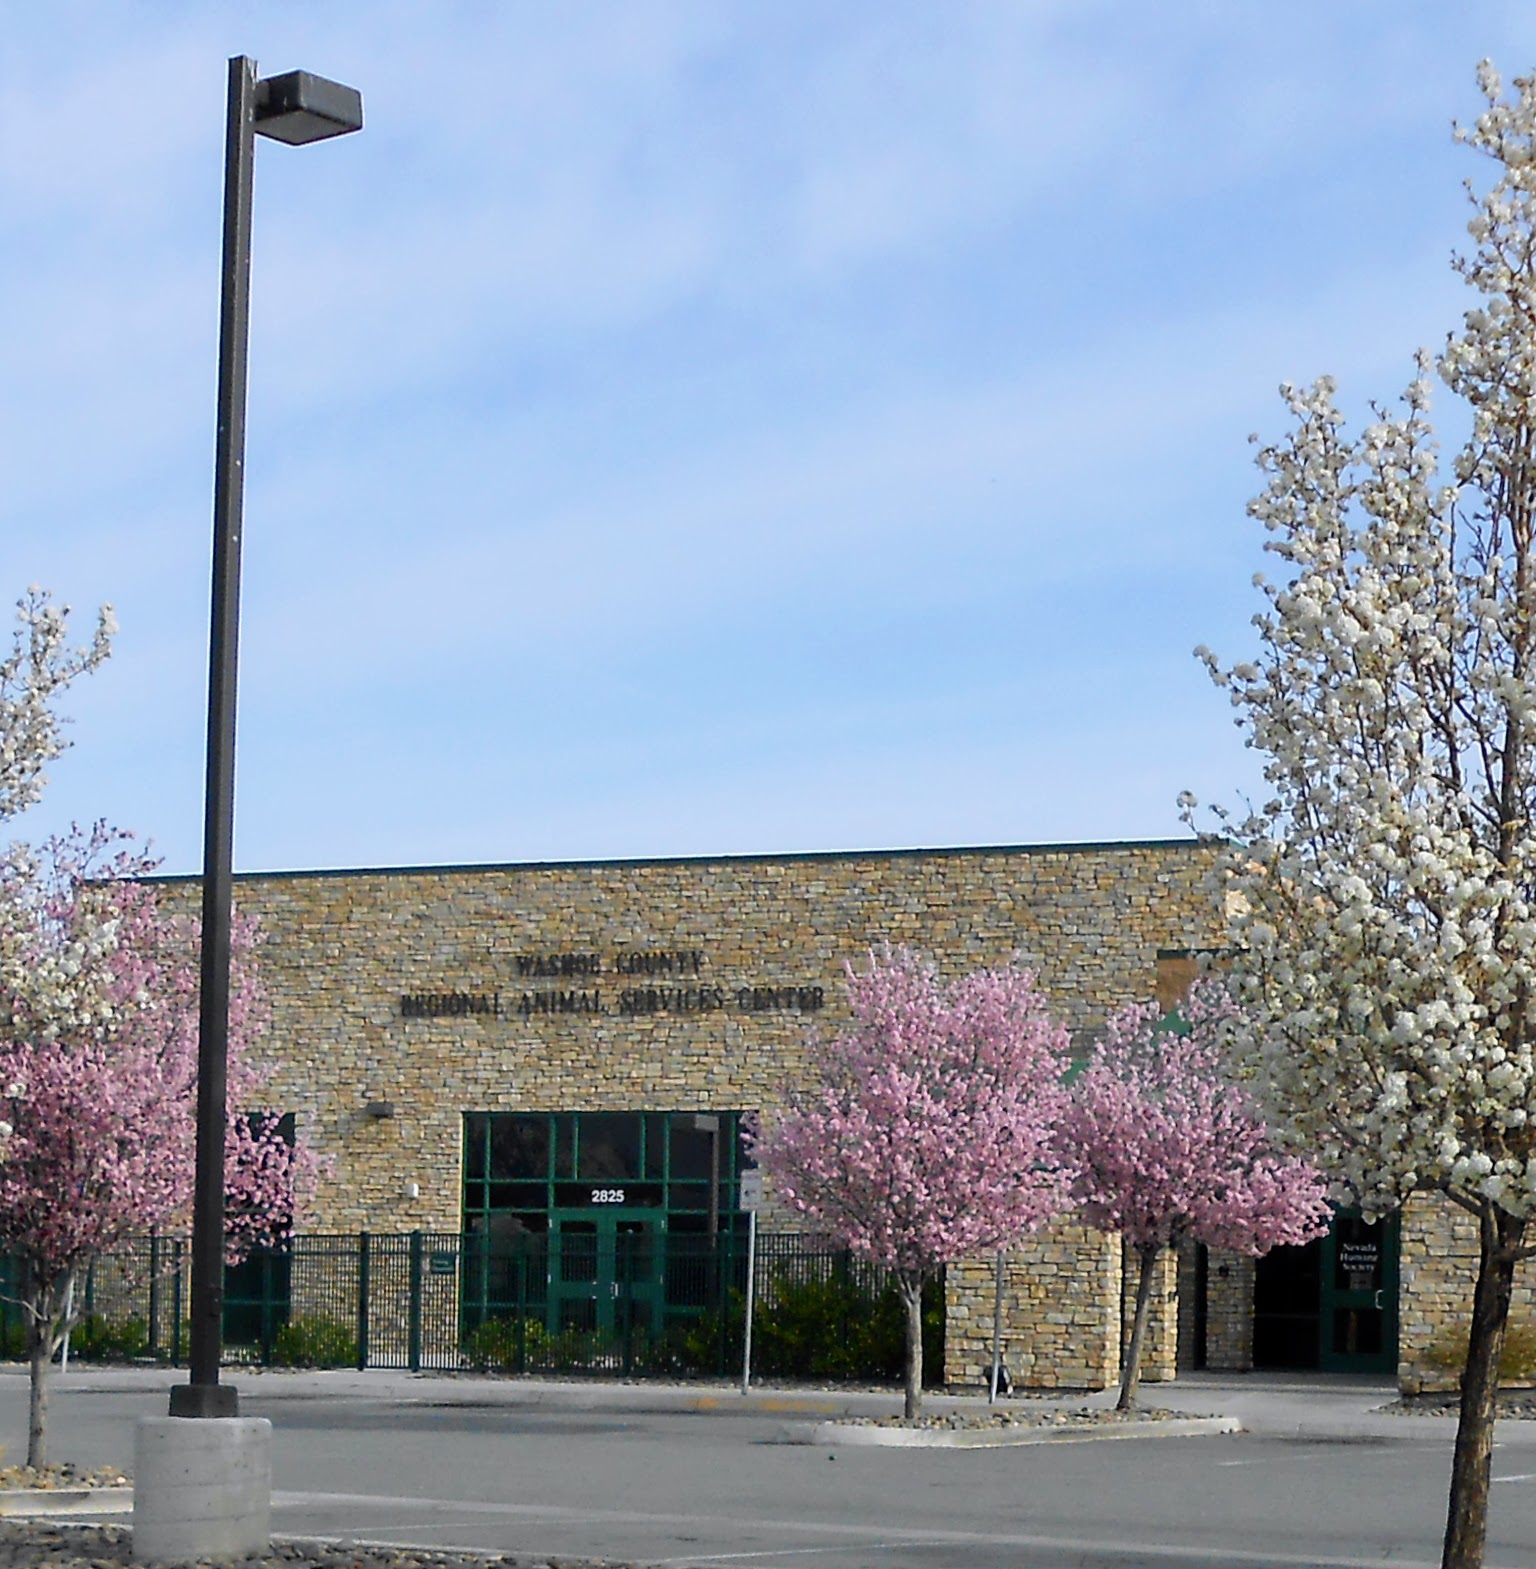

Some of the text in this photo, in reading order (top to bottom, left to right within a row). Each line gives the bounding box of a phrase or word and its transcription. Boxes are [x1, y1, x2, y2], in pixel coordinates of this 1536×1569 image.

[617, 950, 703, 975] COUNTY
[401, 986, 824, 1017] REGIONAL ANIMAL SERVICES CENTER
[591, 1190, 625, 1203] 2825
